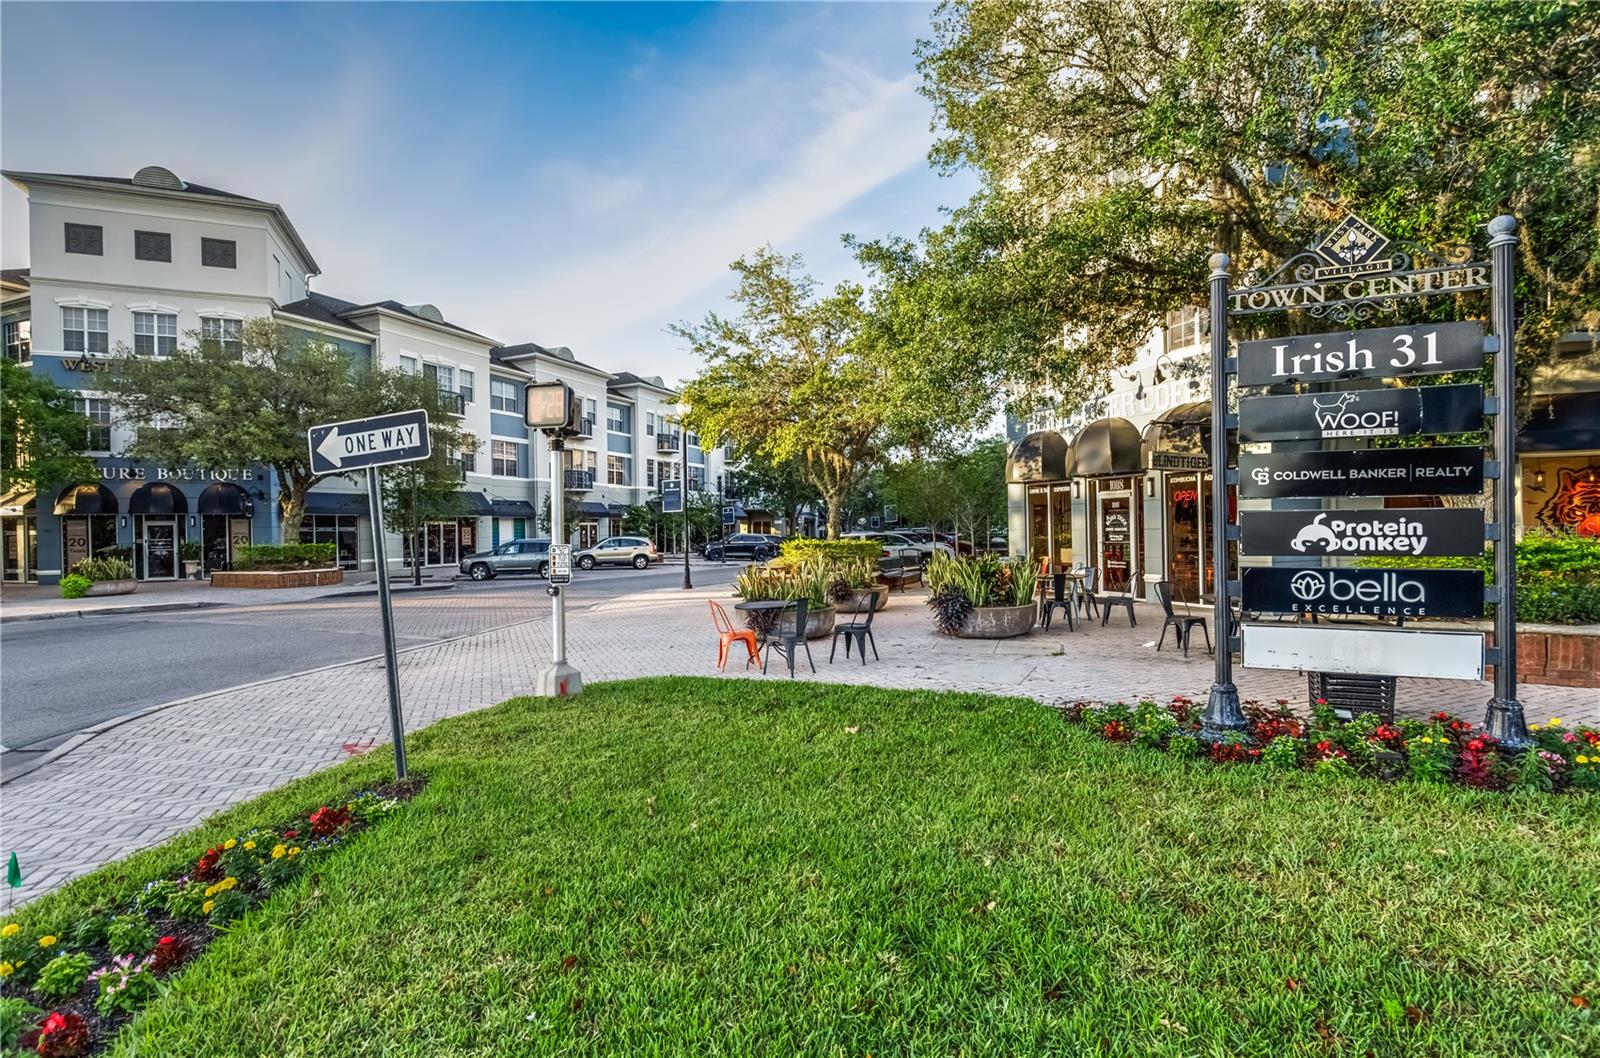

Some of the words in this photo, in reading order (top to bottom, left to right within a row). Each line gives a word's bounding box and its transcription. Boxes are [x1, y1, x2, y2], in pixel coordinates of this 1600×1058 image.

[1324, 223, 1350, 248] WEST
[1353, 222, 1379, 242] PARK
[1324, 263, 1384, 275] VILLAGE
[1228, 284, 1325, 312] TOWN
[1343, 266, 1489, 300] CENTER
[1271, 339, 1375, 377] Irish
[1390, 331, 1443, 368] 31
[62, 359, 112, 373] WEST
[1316, 410, 1399, 430] WOOF!
[344, 433, 376, 454] ONE
[382, 426, 415, 448] WAY
[157, 468, 253, 482] BOUTIQUE
[1273, 470, 1346, 481] COLDWELL
[1349, 468, 1407, 479] BANKER
[1415, 466, 1473, 478] REALTY
[1174, 490, 1197, 502] OPEN
[1331, 517, 1423, 536] Protein
[68, 537, 86, 547] 20
[232, 535, 249, 545] 20
[1329, 571, 1426, 603] bella
[1291, 603, 1426, 616] EXCELLENCE
